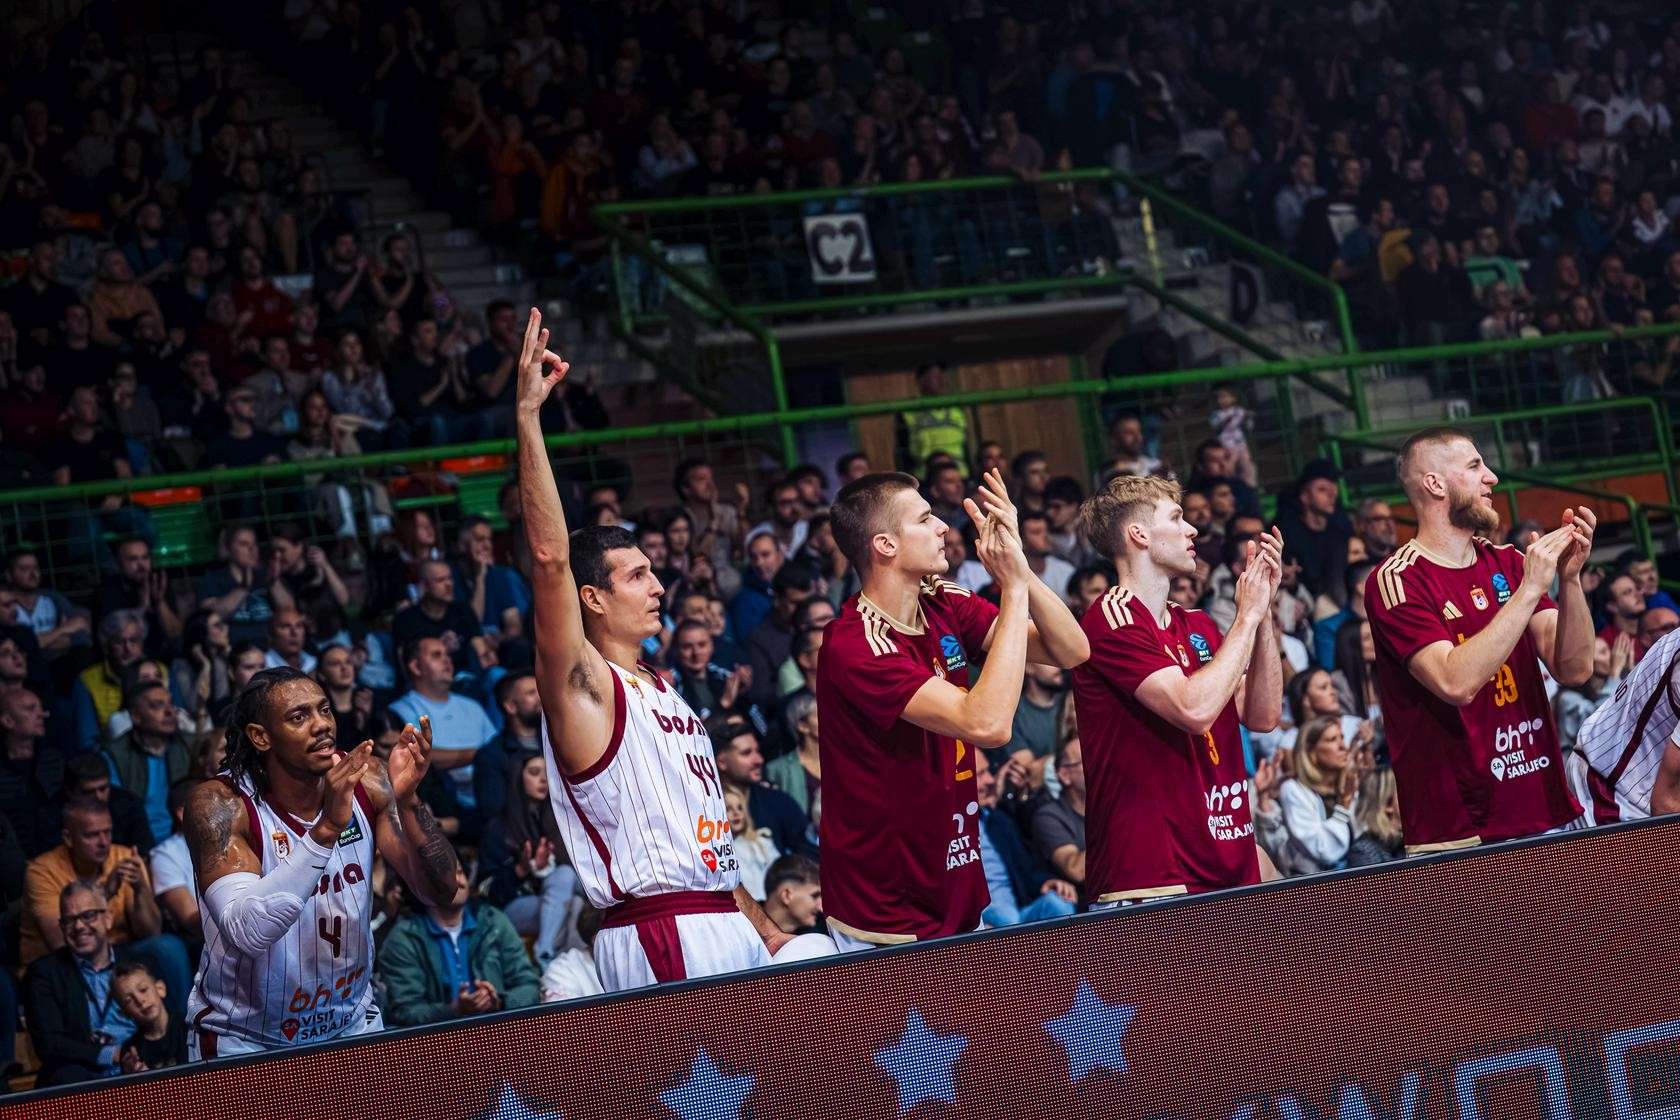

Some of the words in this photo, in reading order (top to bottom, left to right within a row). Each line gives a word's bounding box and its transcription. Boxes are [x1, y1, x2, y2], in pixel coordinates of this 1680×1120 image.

[812, 221, 875, 276] C2
[1231, 264, 1257, 323] D
[686, 753, 721, 799] 44
[1502, 750, 1525, 765] VISIT
[340, 827, 356, 838] BKT
[319, 916, 341, 958] 4
[302, 1009, 335, 1027] VISIT
